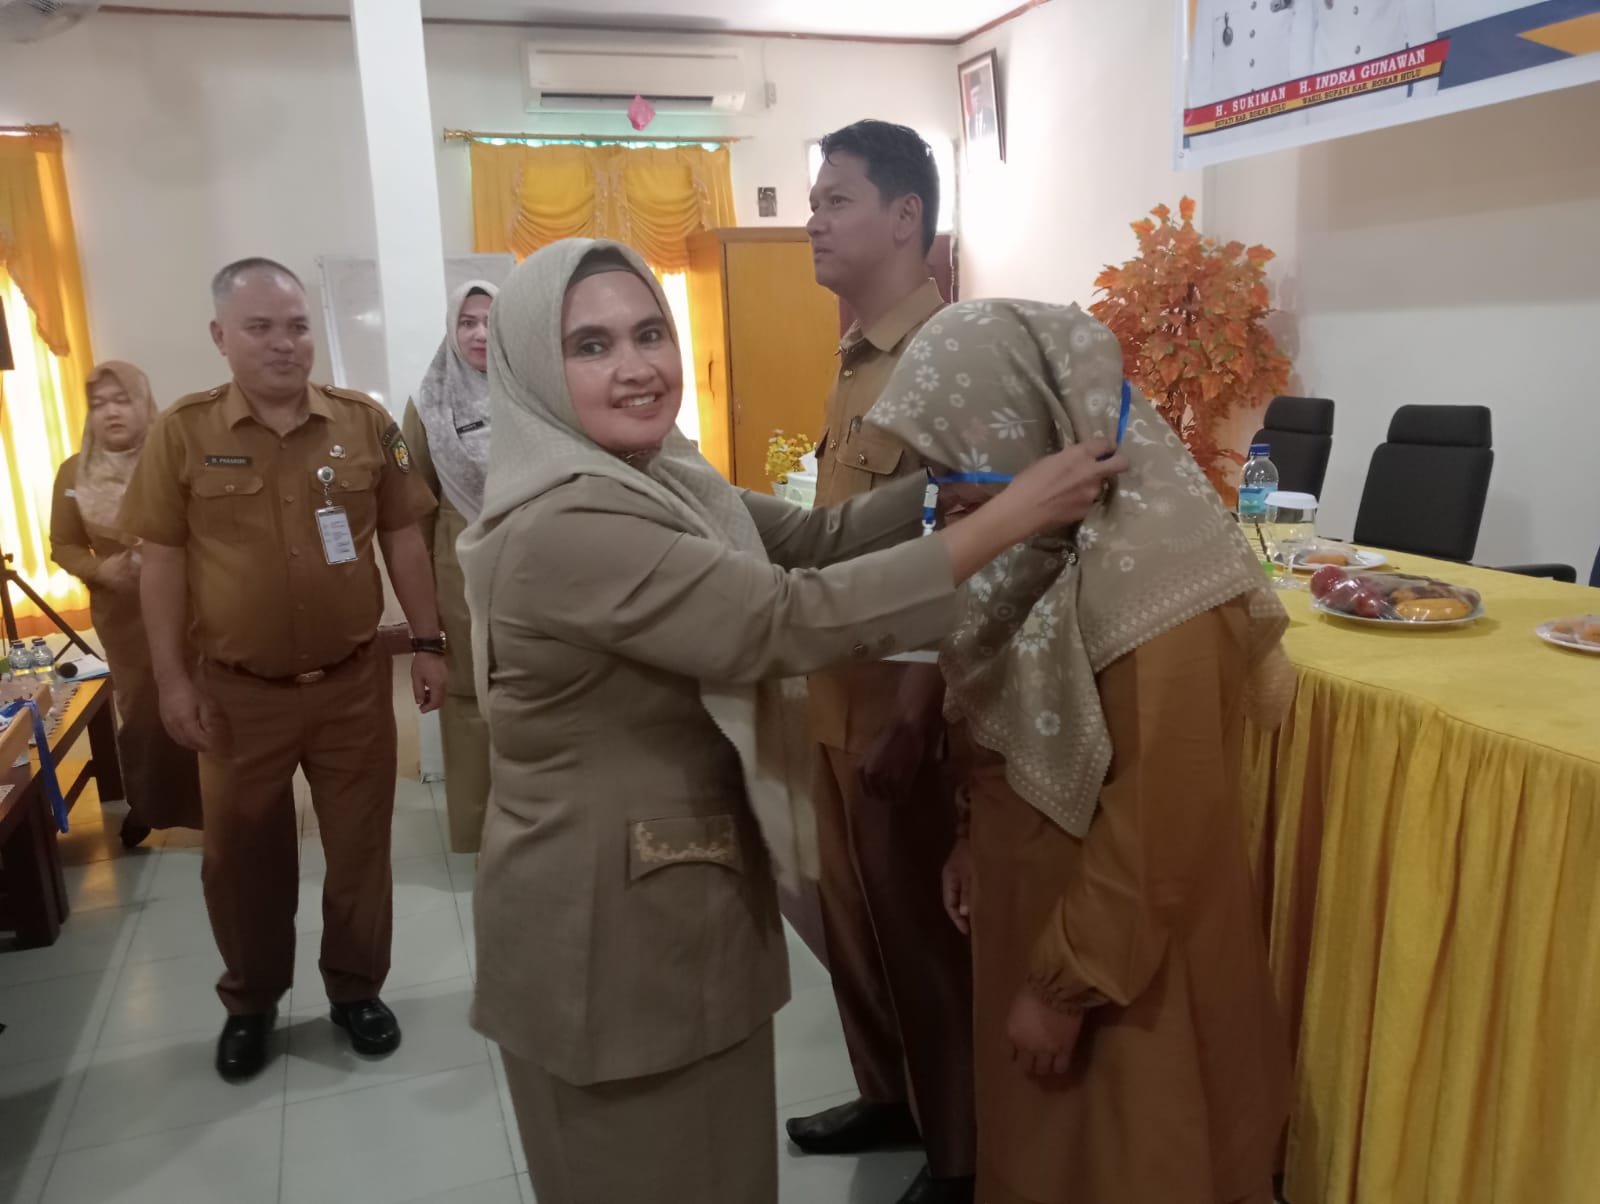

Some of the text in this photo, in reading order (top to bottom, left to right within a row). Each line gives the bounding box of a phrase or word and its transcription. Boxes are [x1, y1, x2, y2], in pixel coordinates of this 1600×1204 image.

[1299, 49, 1425, 94] H. INDRA GUNAWAN
[1216, 87, 1286, 117] H. SUKIMAN
